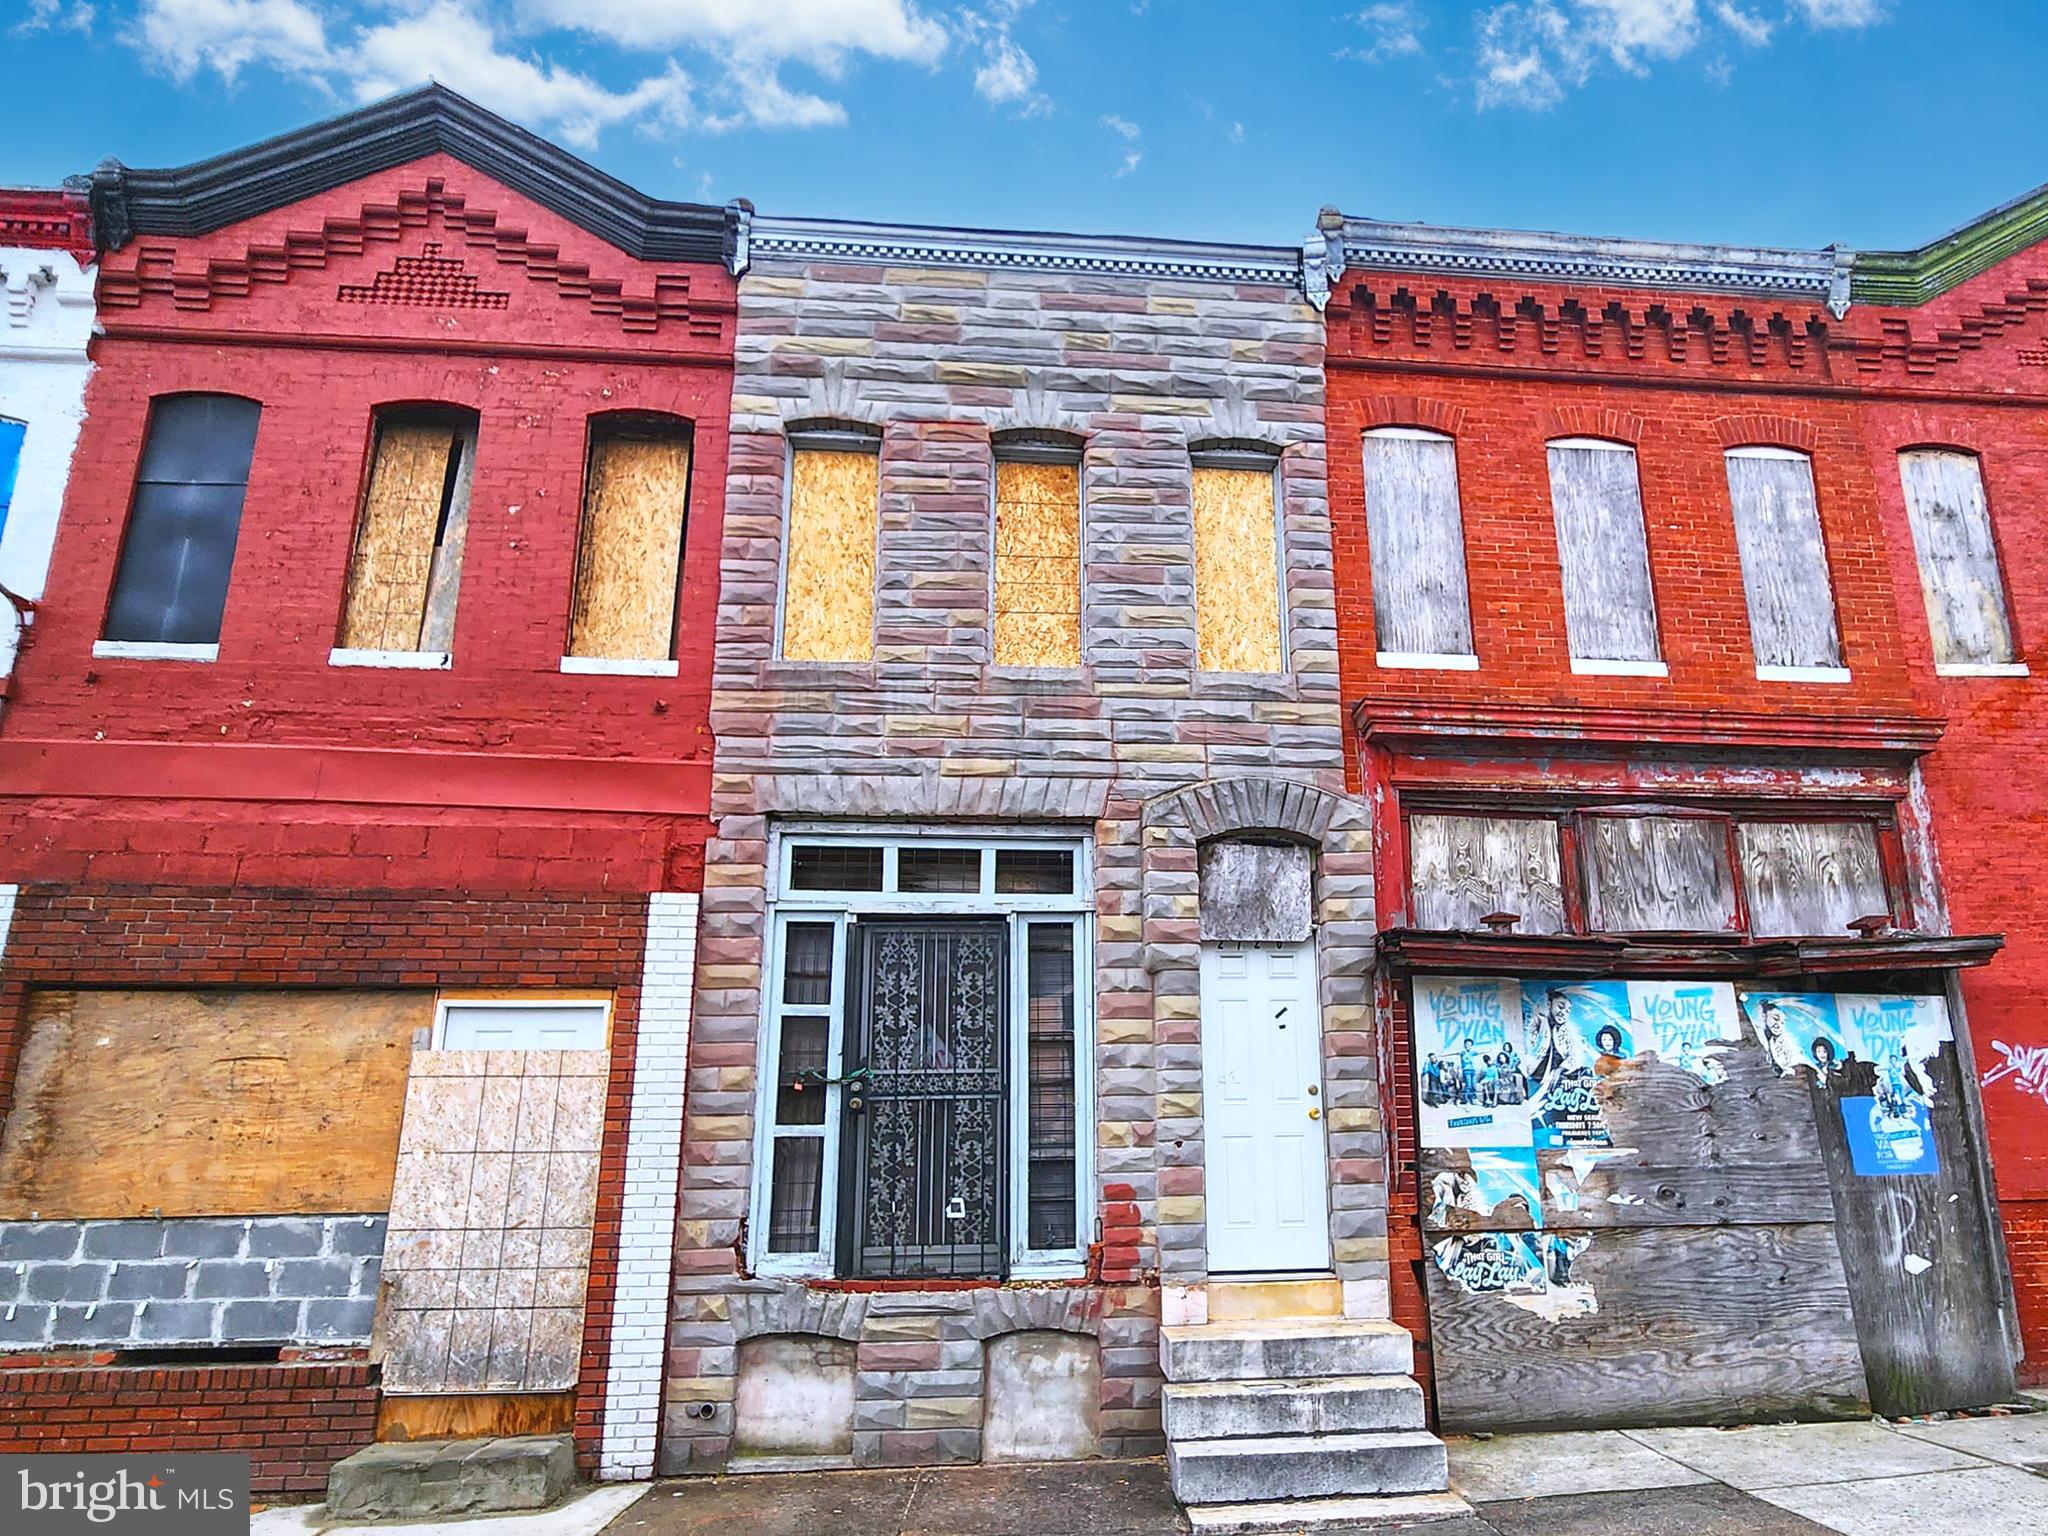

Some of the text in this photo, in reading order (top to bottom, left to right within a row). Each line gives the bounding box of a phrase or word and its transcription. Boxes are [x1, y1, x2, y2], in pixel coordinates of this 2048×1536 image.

[1428, 988, 1501, 1030] YOUNG
[1644, 994, 1715, 1033] YOUNG
[1438, 1017, 1505, 1050] DYLAN
[1653, 1022, 1721, 1052] DYLAN
[1487, 1252, 1508, 1264] GIRL
